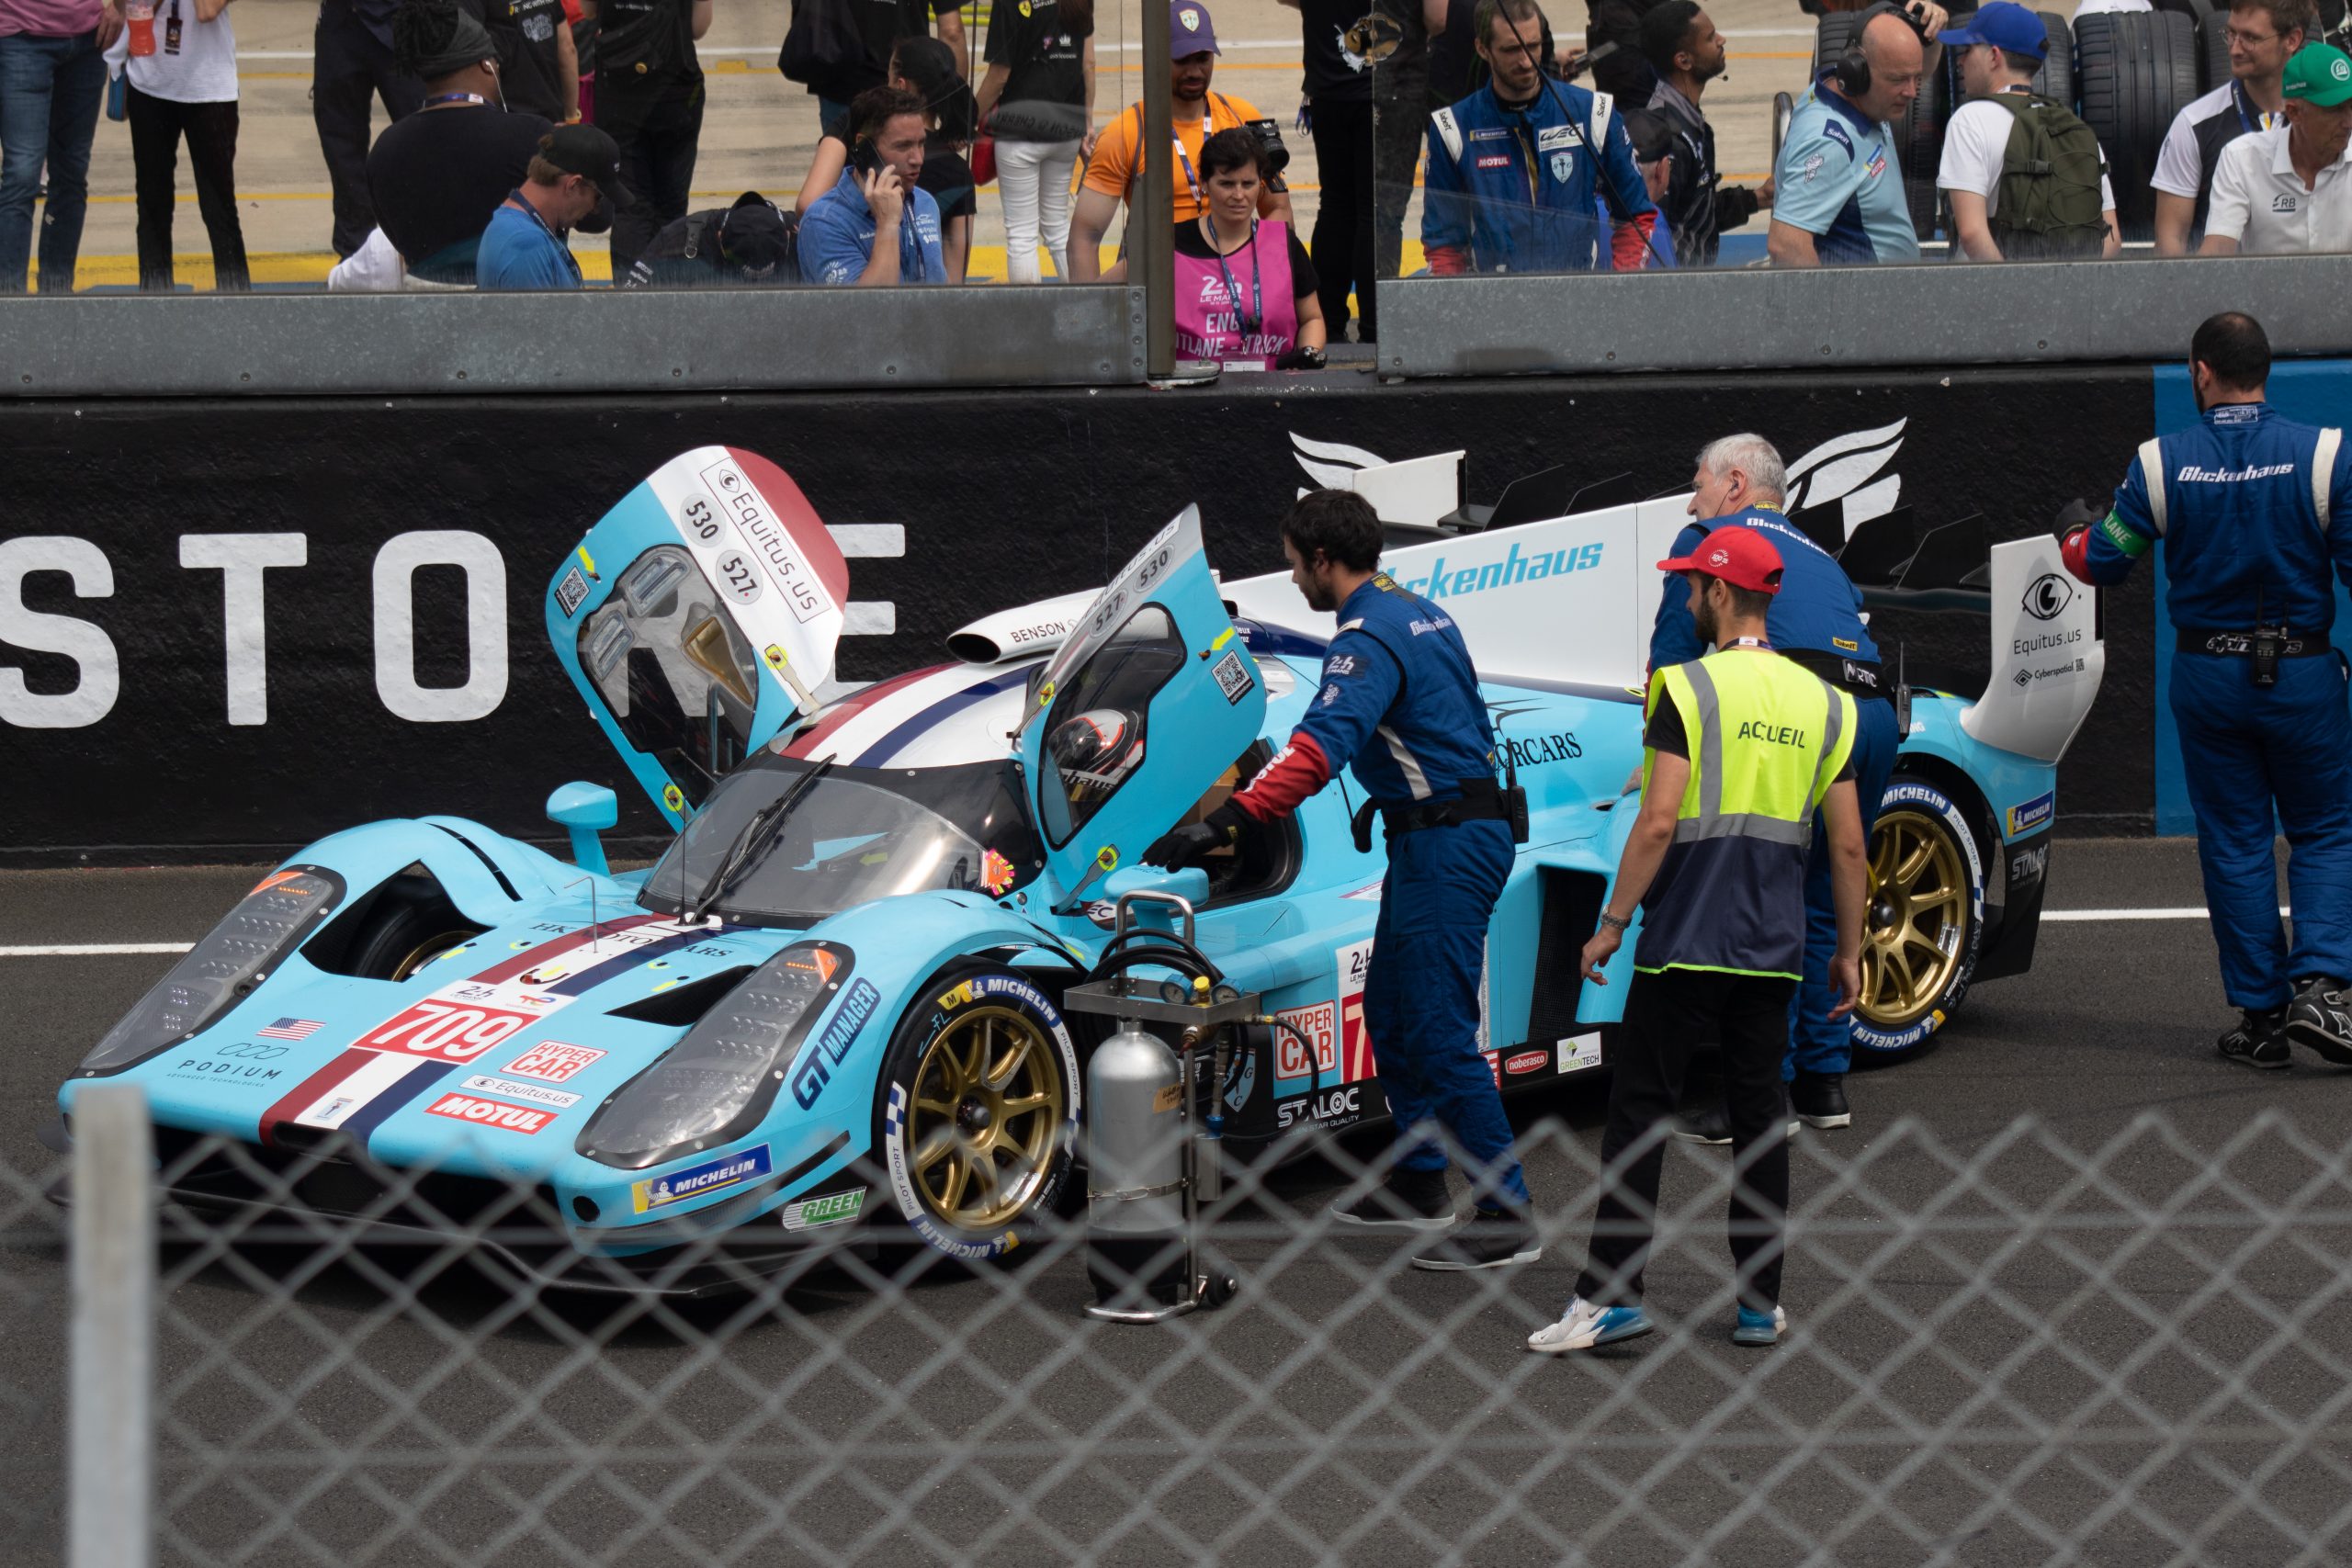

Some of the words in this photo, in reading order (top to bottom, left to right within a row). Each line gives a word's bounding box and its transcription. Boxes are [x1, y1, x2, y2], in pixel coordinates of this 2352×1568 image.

[1597, 96, 1607, 118] Sabelt
[1440, 111, 1453, 131] Sabelt
[1826, 128, 1850, 145] Sabelt
[1478, 157, 1509, 167] MOTUL
[2281, 197, 2296, 209] RB
[1200, 295, 1212, 303] LE
[1176, 332, 1226, 357] ITLANE
[2177, 464, 2294, 483] Glickenhaus
[685, 500, 718, 540] 530
[731, 491, 818, 612] Equitus.us
[721, 556, 759, 598] 527
[1140, 549, 1169, 587] 530
[1386, 541, 1604, 603] ckenhaus
[1095, 592, 1122, 631] 527
[1011, 622, 1067, 644] BENSON
[2014, 628, 2082, 657] Equitus.us
[2034, 661, 2074, 681] Cyberspatial
[1737, 720, 1806, 749] ACUEIL
[1495, 731, 1583, 769] ORCARS
[1882, 786, 1946, 809] MICHELIN
[2024, 801, 2051, 823] MICHELIN
[1952, 814, 1968, 840] PILOT
[1965, 831, 1978, 866] SPORT
[530, 922, 572, 934] HK
[1350, 975, 1358, 984] LE
[947, 994, 956, 1007] M
[988, 978, 1057, 1021] MICHELIN
[370, 1003, 524, 1057] 709
[1279, 1008, 1332, 1038] HYPER
[792, 1043, 831, 1111] GT
[824, 981, 877, 1060] MANAGER
[1852, 1025, 1922, 1049] MICHELIN
[528, 1043, 598, 1064] HYPER
[1281, 1030, 1332, 1073] CAR
[1509, 1054, 1545, 1071] noberasco
[1559, 1055, 1600, 1072] GREENTECH
[177, 1059, 283, 1080] PODIUM
[511, 1055, 582, 1080] CAR
[1060, 1031, 1074, 1059] PILOT
[1070, 1062, 1080, 1098] SPORT
[495, 1081, 571, 1105] Equitus.us
[434, 1097, 545, 1131] MOTUL
[1309, 1120, 1329, 1133] STAR
[1329, 1113, 1360, 1128] QUALITY
[675, 1158, 756, 1193] MICHELIN
[892, 1146, 904, 1181] SPORT
[800, 1190, 865, 1219] GREEN
[900, 1185, 914, 1211] PILOT
[916, 1221, 991, 1258] MICHELIN
